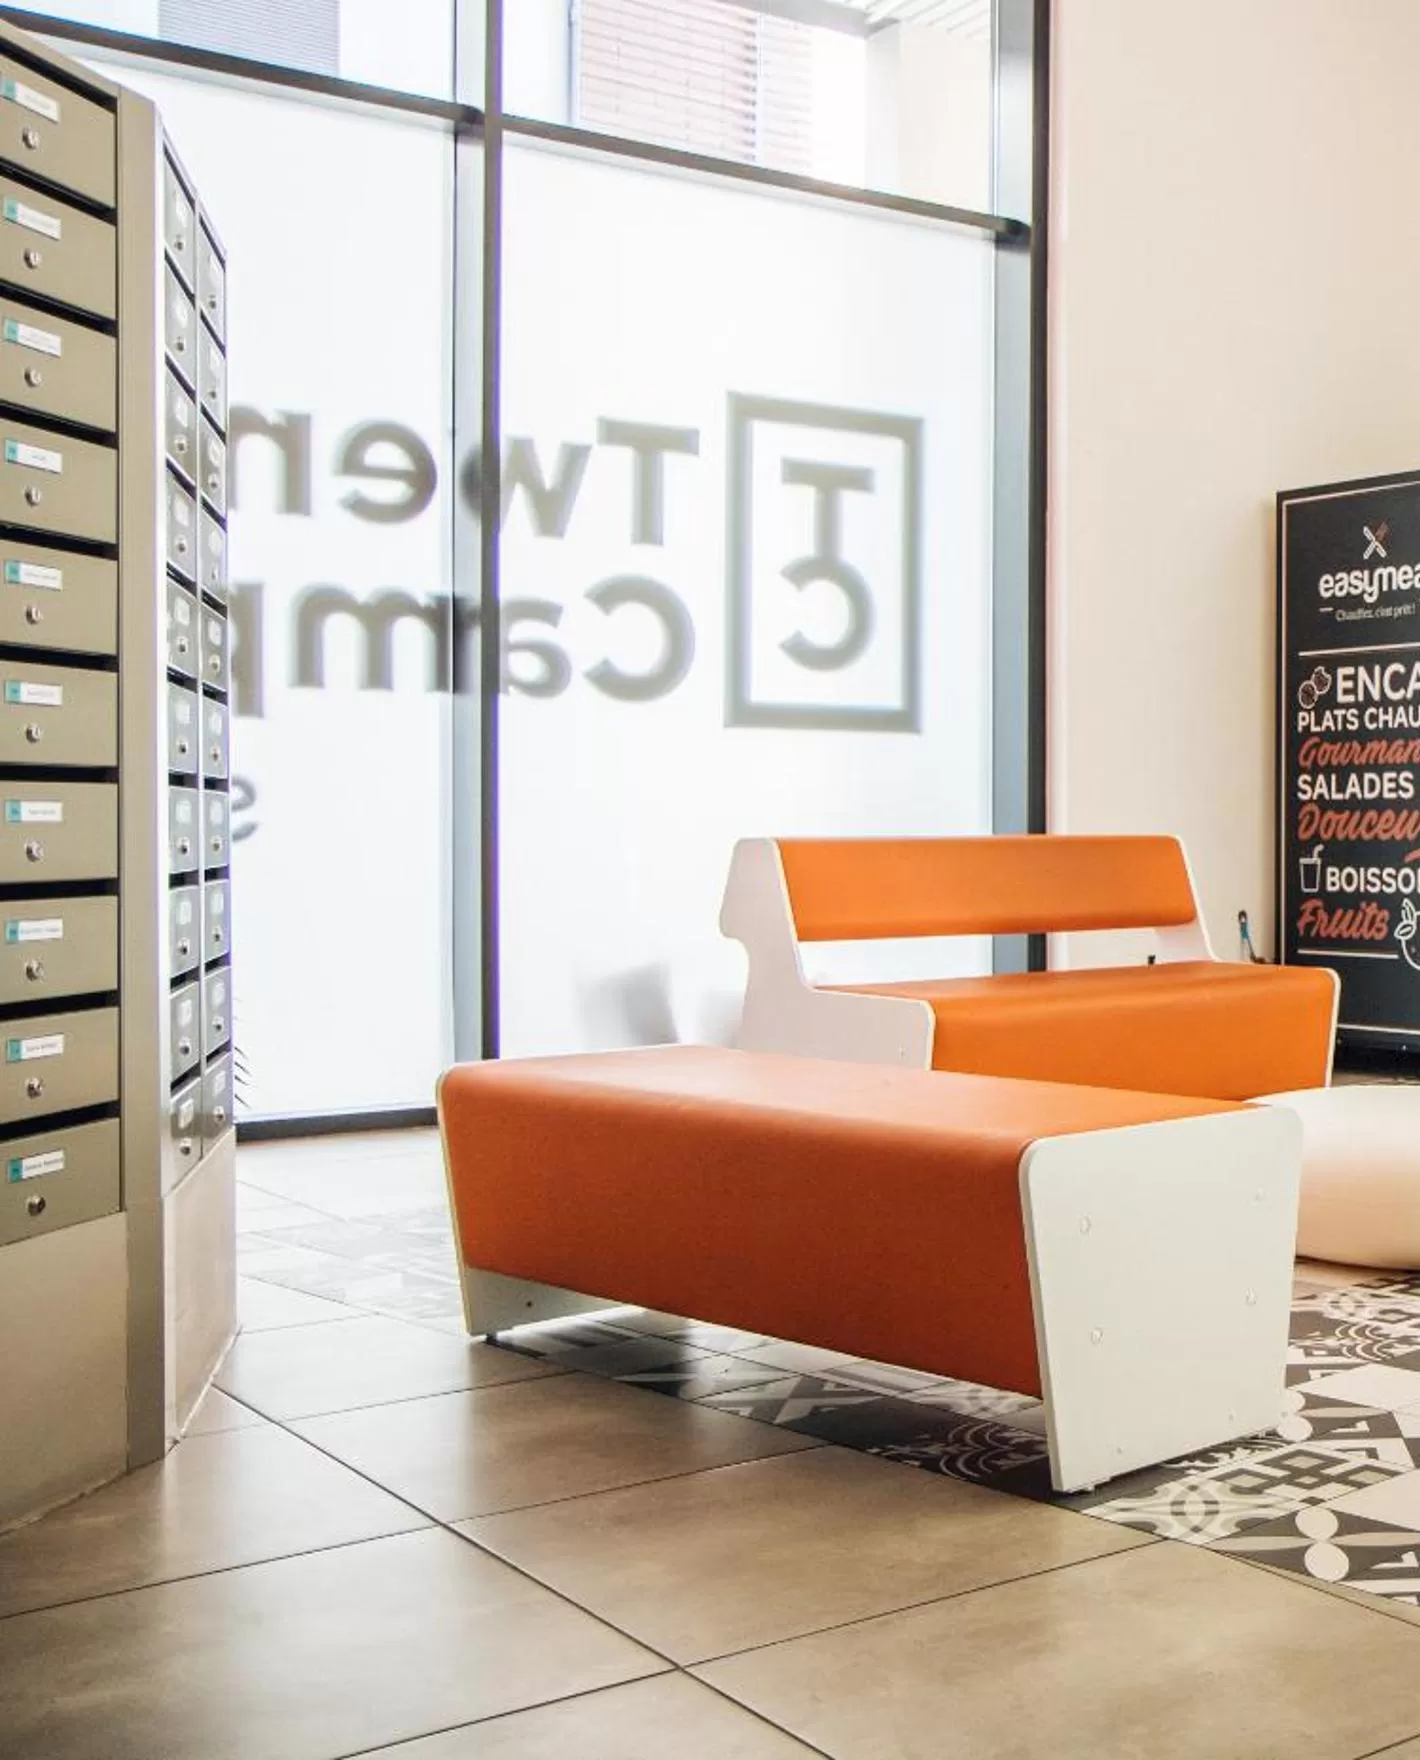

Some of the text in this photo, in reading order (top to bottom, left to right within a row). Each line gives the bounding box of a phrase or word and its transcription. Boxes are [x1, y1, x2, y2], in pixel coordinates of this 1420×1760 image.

[1297, 708, 1359, 733] PLATS
[1297, 771, 1414, 800] SALADES
[1297, 898, 1390, 940] Fruits
